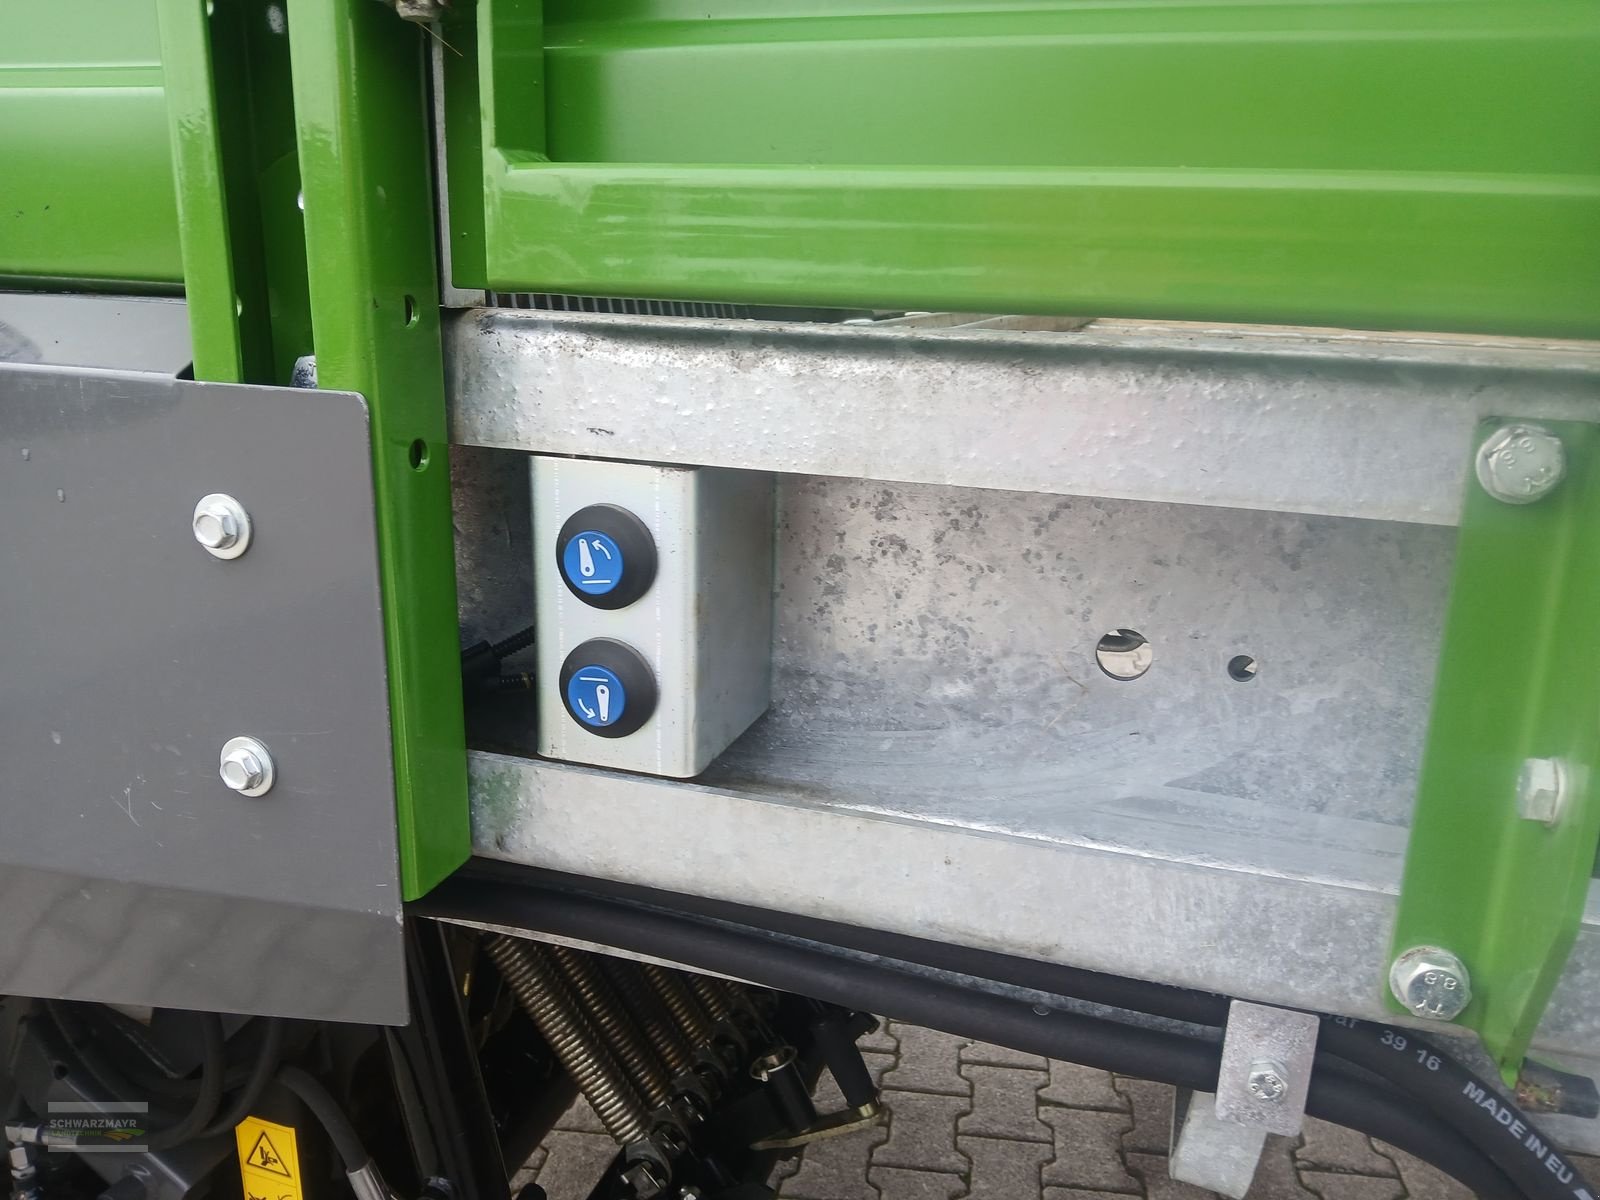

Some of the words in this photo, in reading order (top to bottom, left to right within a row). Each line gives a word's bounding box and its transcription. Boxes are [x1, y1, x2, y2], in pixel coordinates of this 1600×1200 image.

[1380, 1030, 1407, 1051] 39
[1417, 1049, 1442, 1071] 16
[1462, 1081, 1527, 1139] MADE
[1524, 1133, 1548, 1159] IN
[1544, 1153, 1574, 1184] EU
